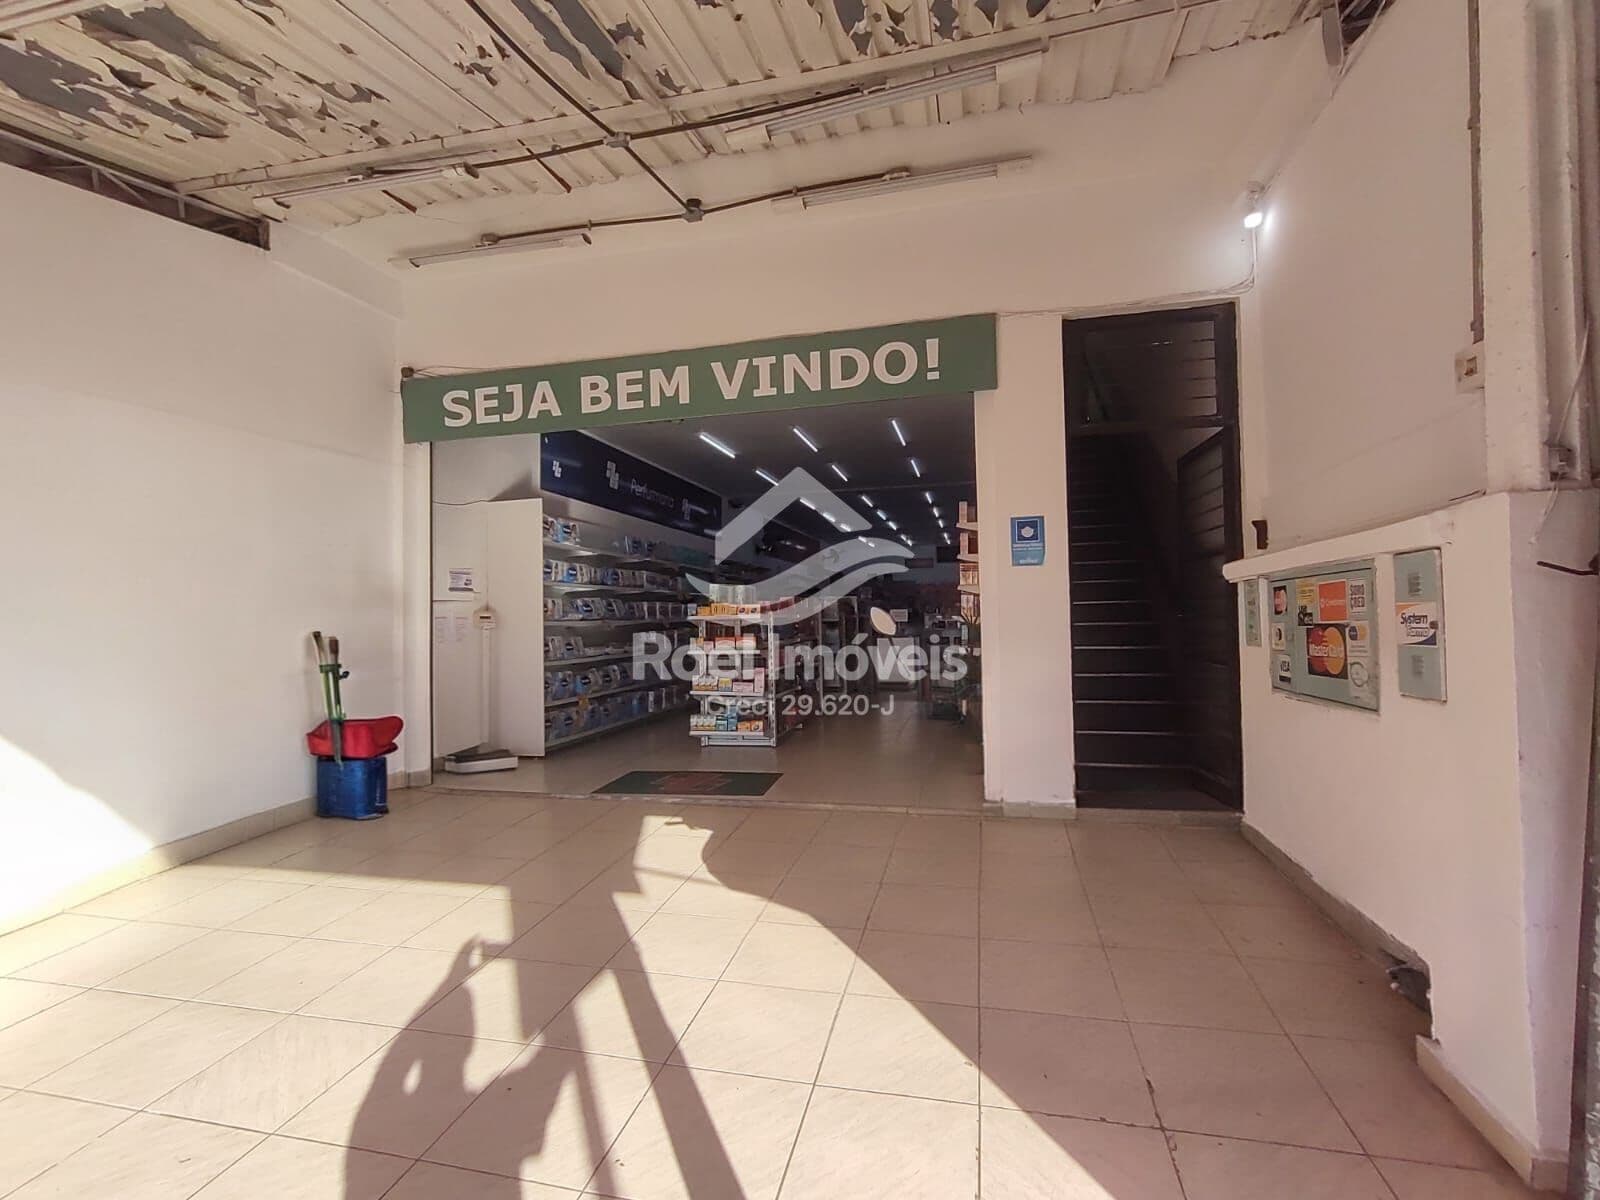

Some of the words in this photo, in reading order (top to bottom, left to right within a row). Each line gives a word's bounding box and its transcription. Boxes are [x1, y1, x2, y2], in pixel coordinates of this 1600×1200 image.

[442, 380, 562, 428] SEJA
[580, 365, 690, 414] BEM
[710, 338, 941, 401] VINDO!
[1400, 612, 1429, 628] System
